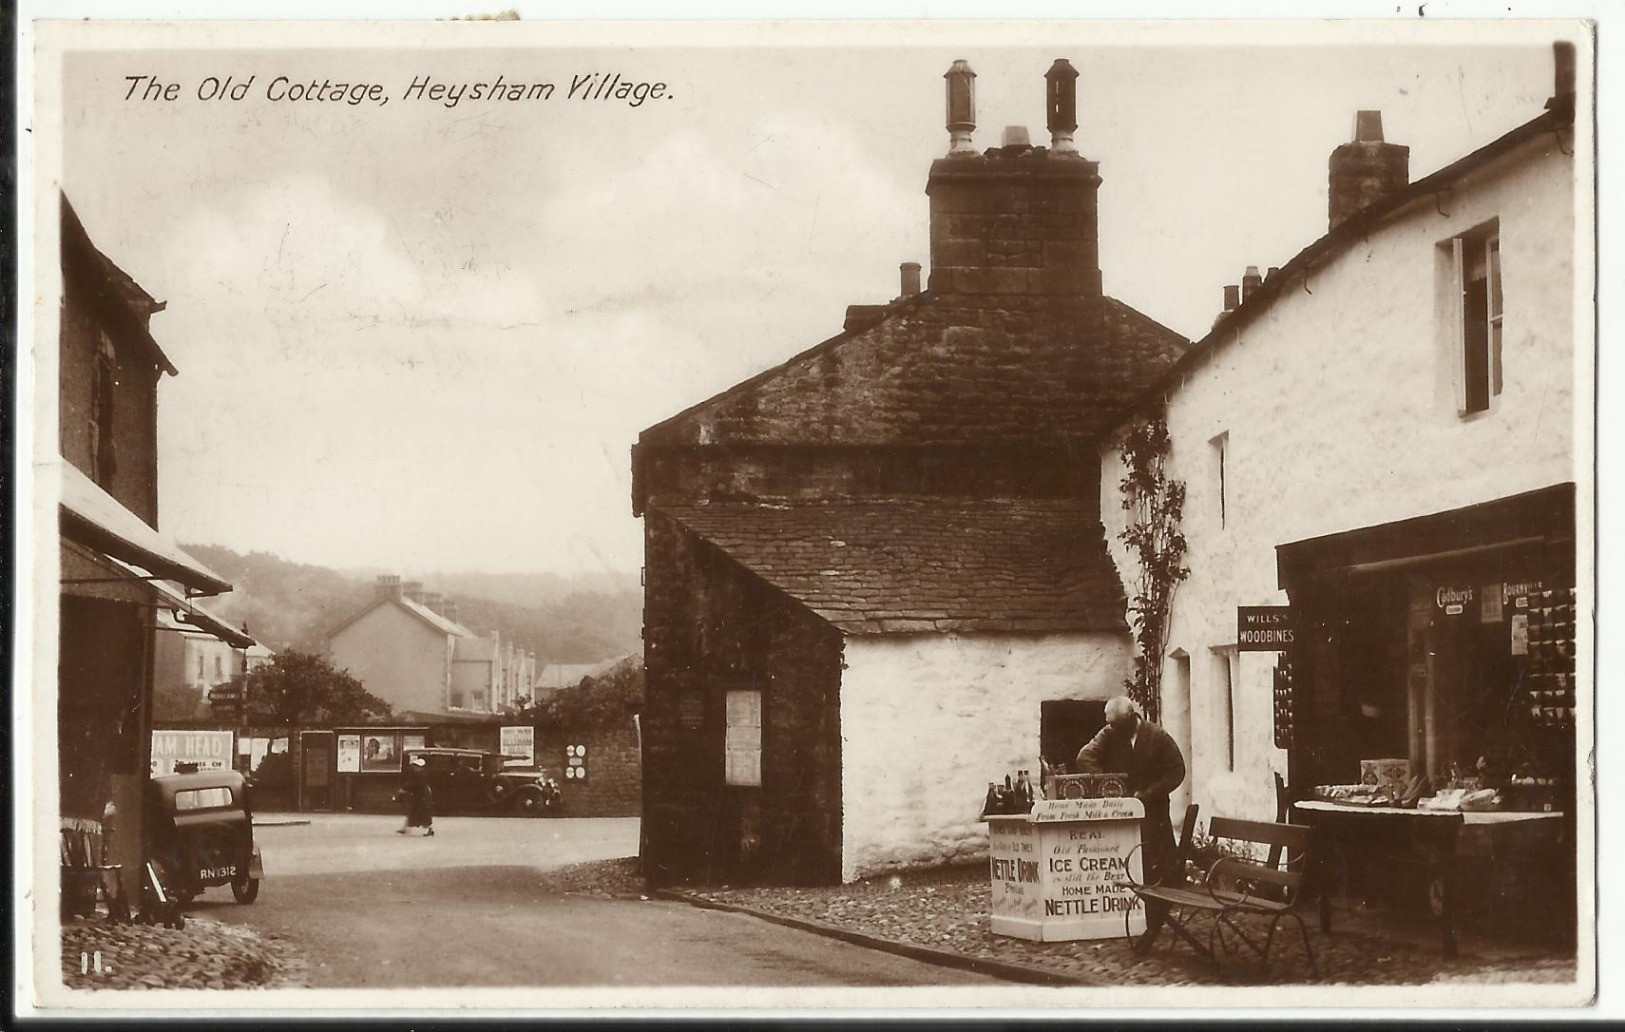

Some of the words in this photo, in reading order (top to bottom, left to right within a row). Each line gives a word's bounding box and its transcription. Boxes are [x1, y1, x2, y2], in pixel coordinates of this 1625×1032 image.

[1437, 586, 1473, 608] Cadbury's
[1240, 629, 1295, 644] WOODBINES
[185, 735, 223, 757] HEAD
[1048, 802, 1069, 810] Home
[1076, 801, 1097, 809] Made
[1036, 813, 1056, 822] From
[1060, 812, 1080, 820] Fresh
[1085, 810, 1101, 819] Milk
[1111, 810, 1134, 818] Cream
[1069, 829, 1105, 840] REAL
[1053, 845, 1072, 855] Old
[991, 856, 1015, 882] NETTLE
[1018, 857, 1039, 883] DRINK
[1049, 857, 1073, 873] ICE
[1079, 856, 1129, 872] CREAM
[200, 868, 216, 880] RN
[1086, 871, 1101, 882] the
[1062, 885, 1092, 896] HOME
[1095, 884, 1127, 894] MADE
[1045, 898, 1099, 916] NETTLE
[1102, 895, 1142, 913] DRINK
